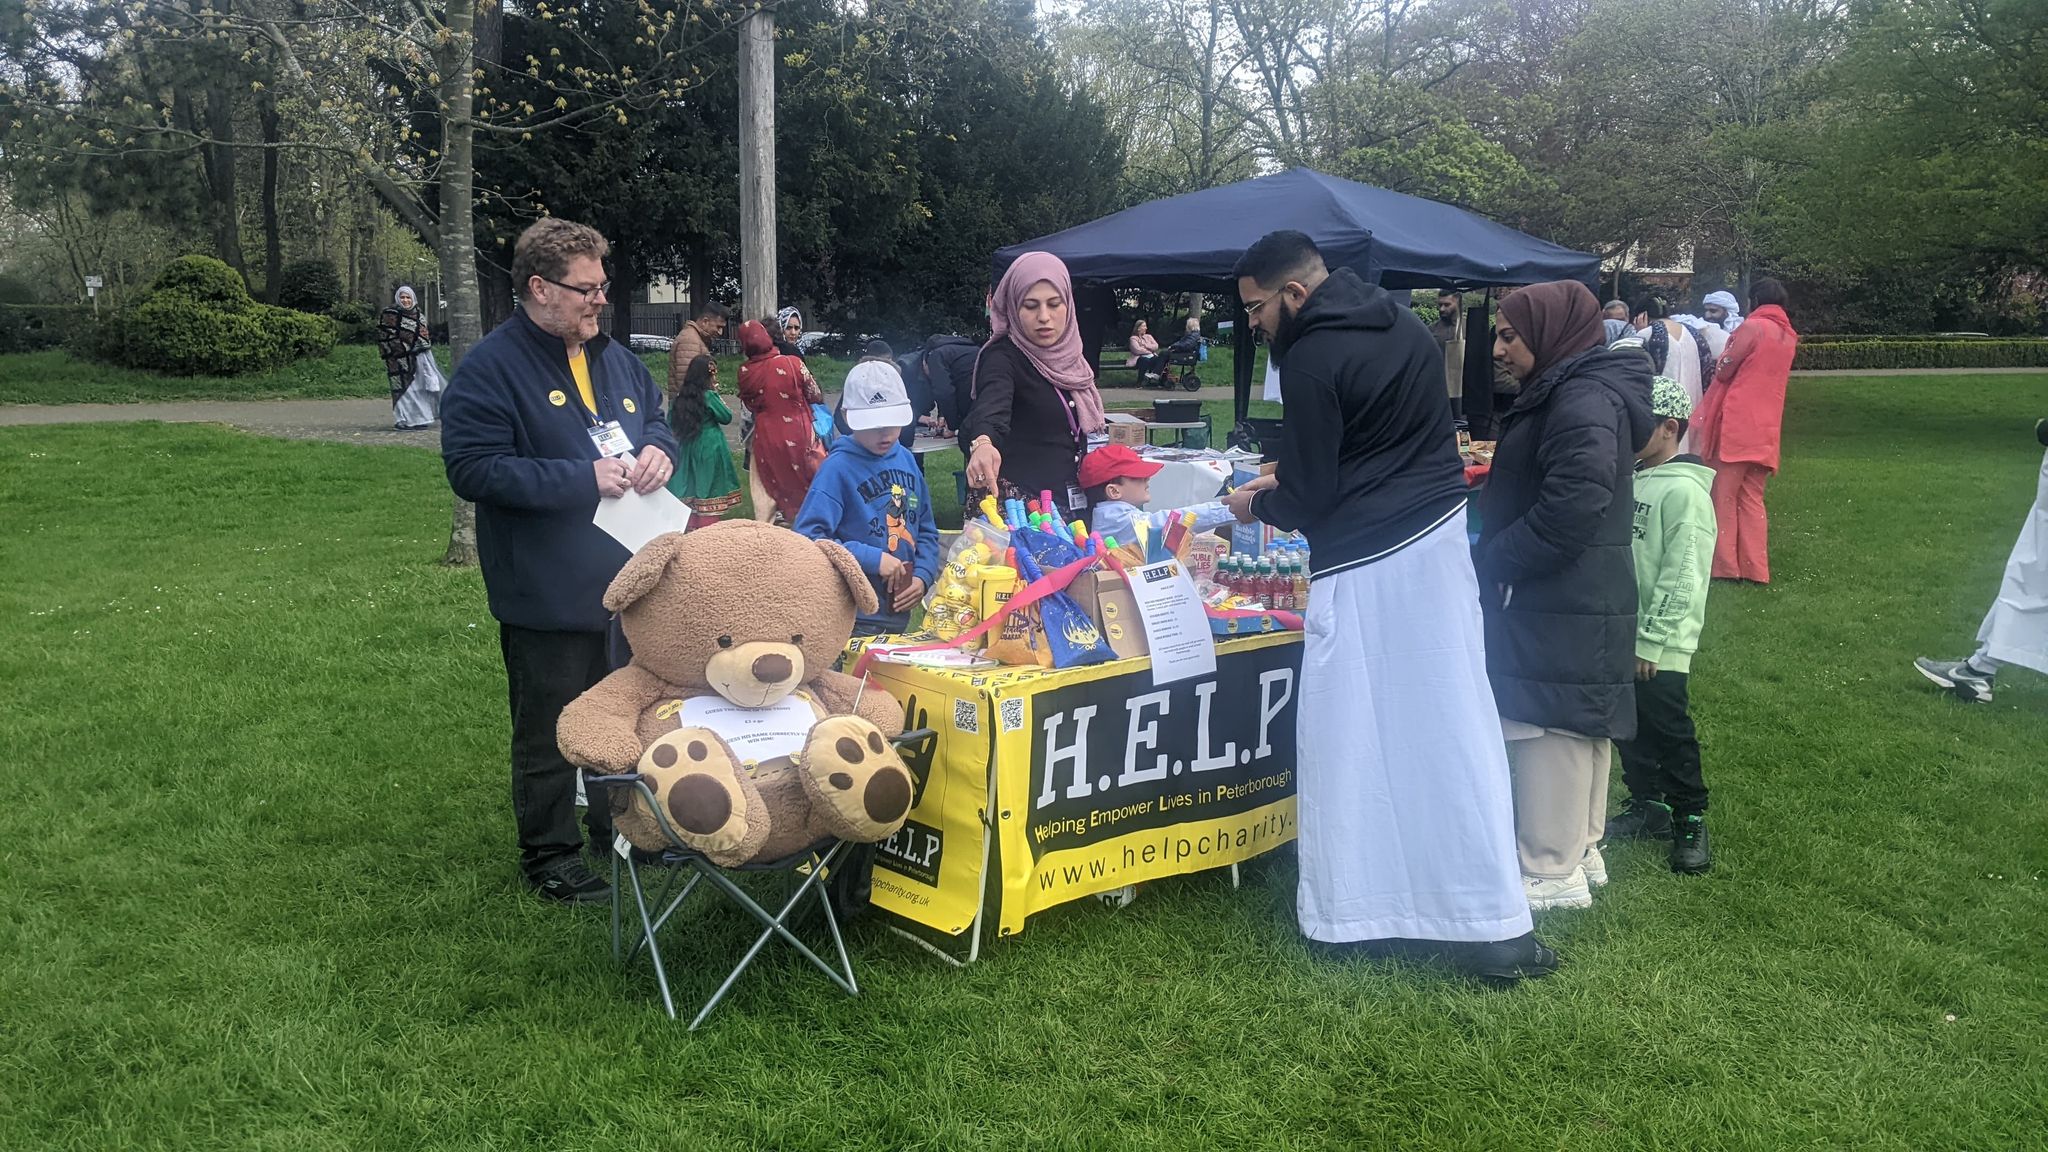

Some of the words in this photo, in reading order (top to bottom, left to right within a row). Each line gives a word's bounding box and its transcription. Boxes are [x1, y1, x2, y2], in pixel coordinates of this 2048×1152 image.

[857, 469, 915, 504] NARUTO
[1197, 561, 1211, 570] LIES
[1037, 667, 1294, 810] H.E.L.P
[1034, 817, 1086, 844] Helping
[1090, 799, 1153, 828] Empower
[1159, 792, 1193, 812] Lives
[1198, 789, 1212, 804] in
[1217, 768, 1292, 801] Peterborough
[875, 826, 940, 868] .E.L.P
